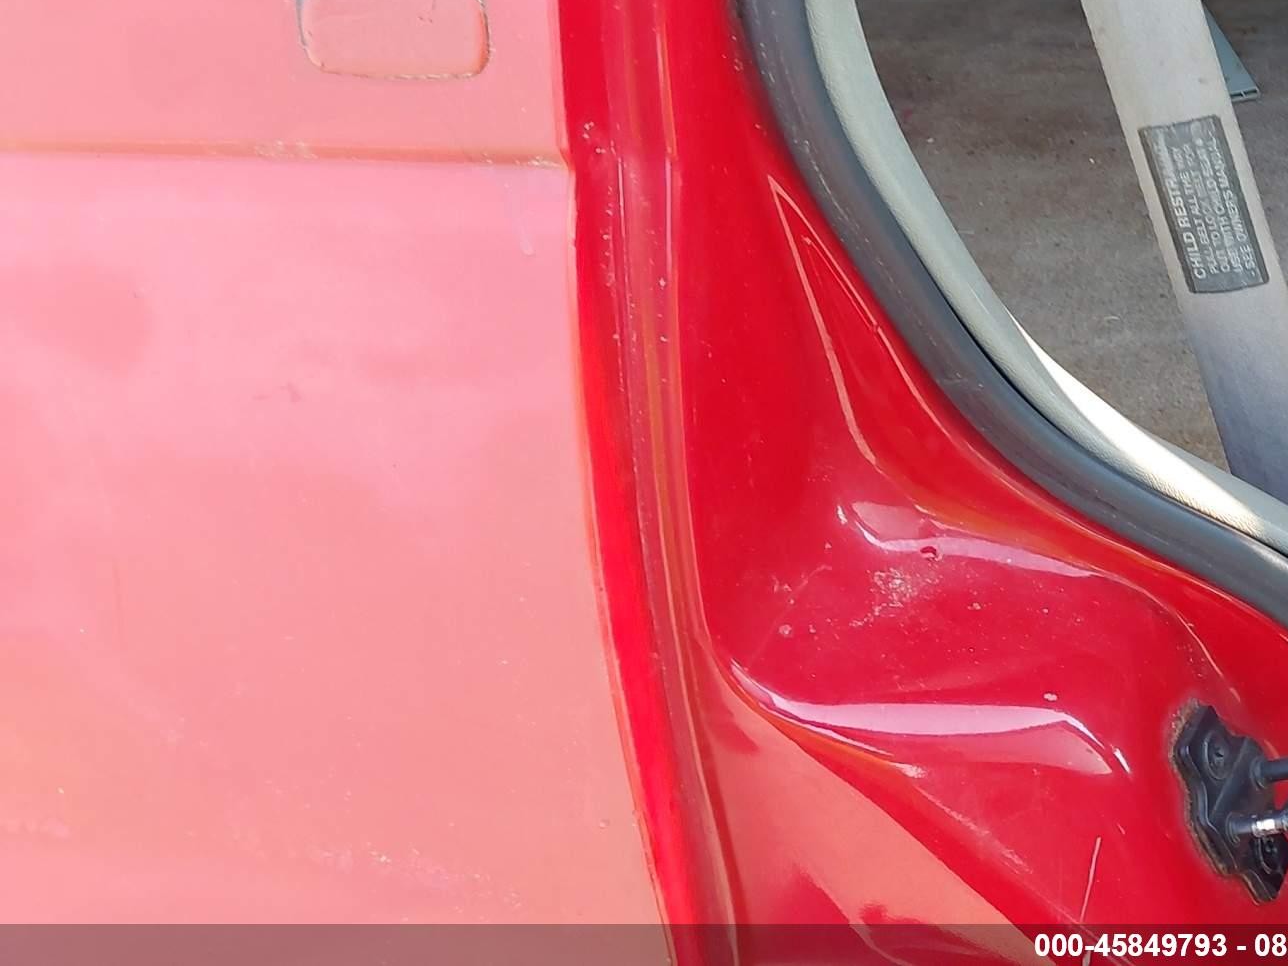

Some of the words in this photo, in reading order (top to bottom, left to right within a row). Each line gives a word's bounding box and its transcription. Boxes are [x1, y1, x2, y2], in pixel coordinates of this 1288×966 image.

[1180, 171, 1194, 194] THE
[1188, 194, 1201, 215] ALL
[1194, 217, 1209, 244] BELT
[1183, 231, 1206, 278] CHILD
[1203, 246, 1219, 274] PULL
[1215, 249, 1230, 273] OUT
[1227, 249, 1242, 272] USE
[1240, 245, 1255, 270] SEE
